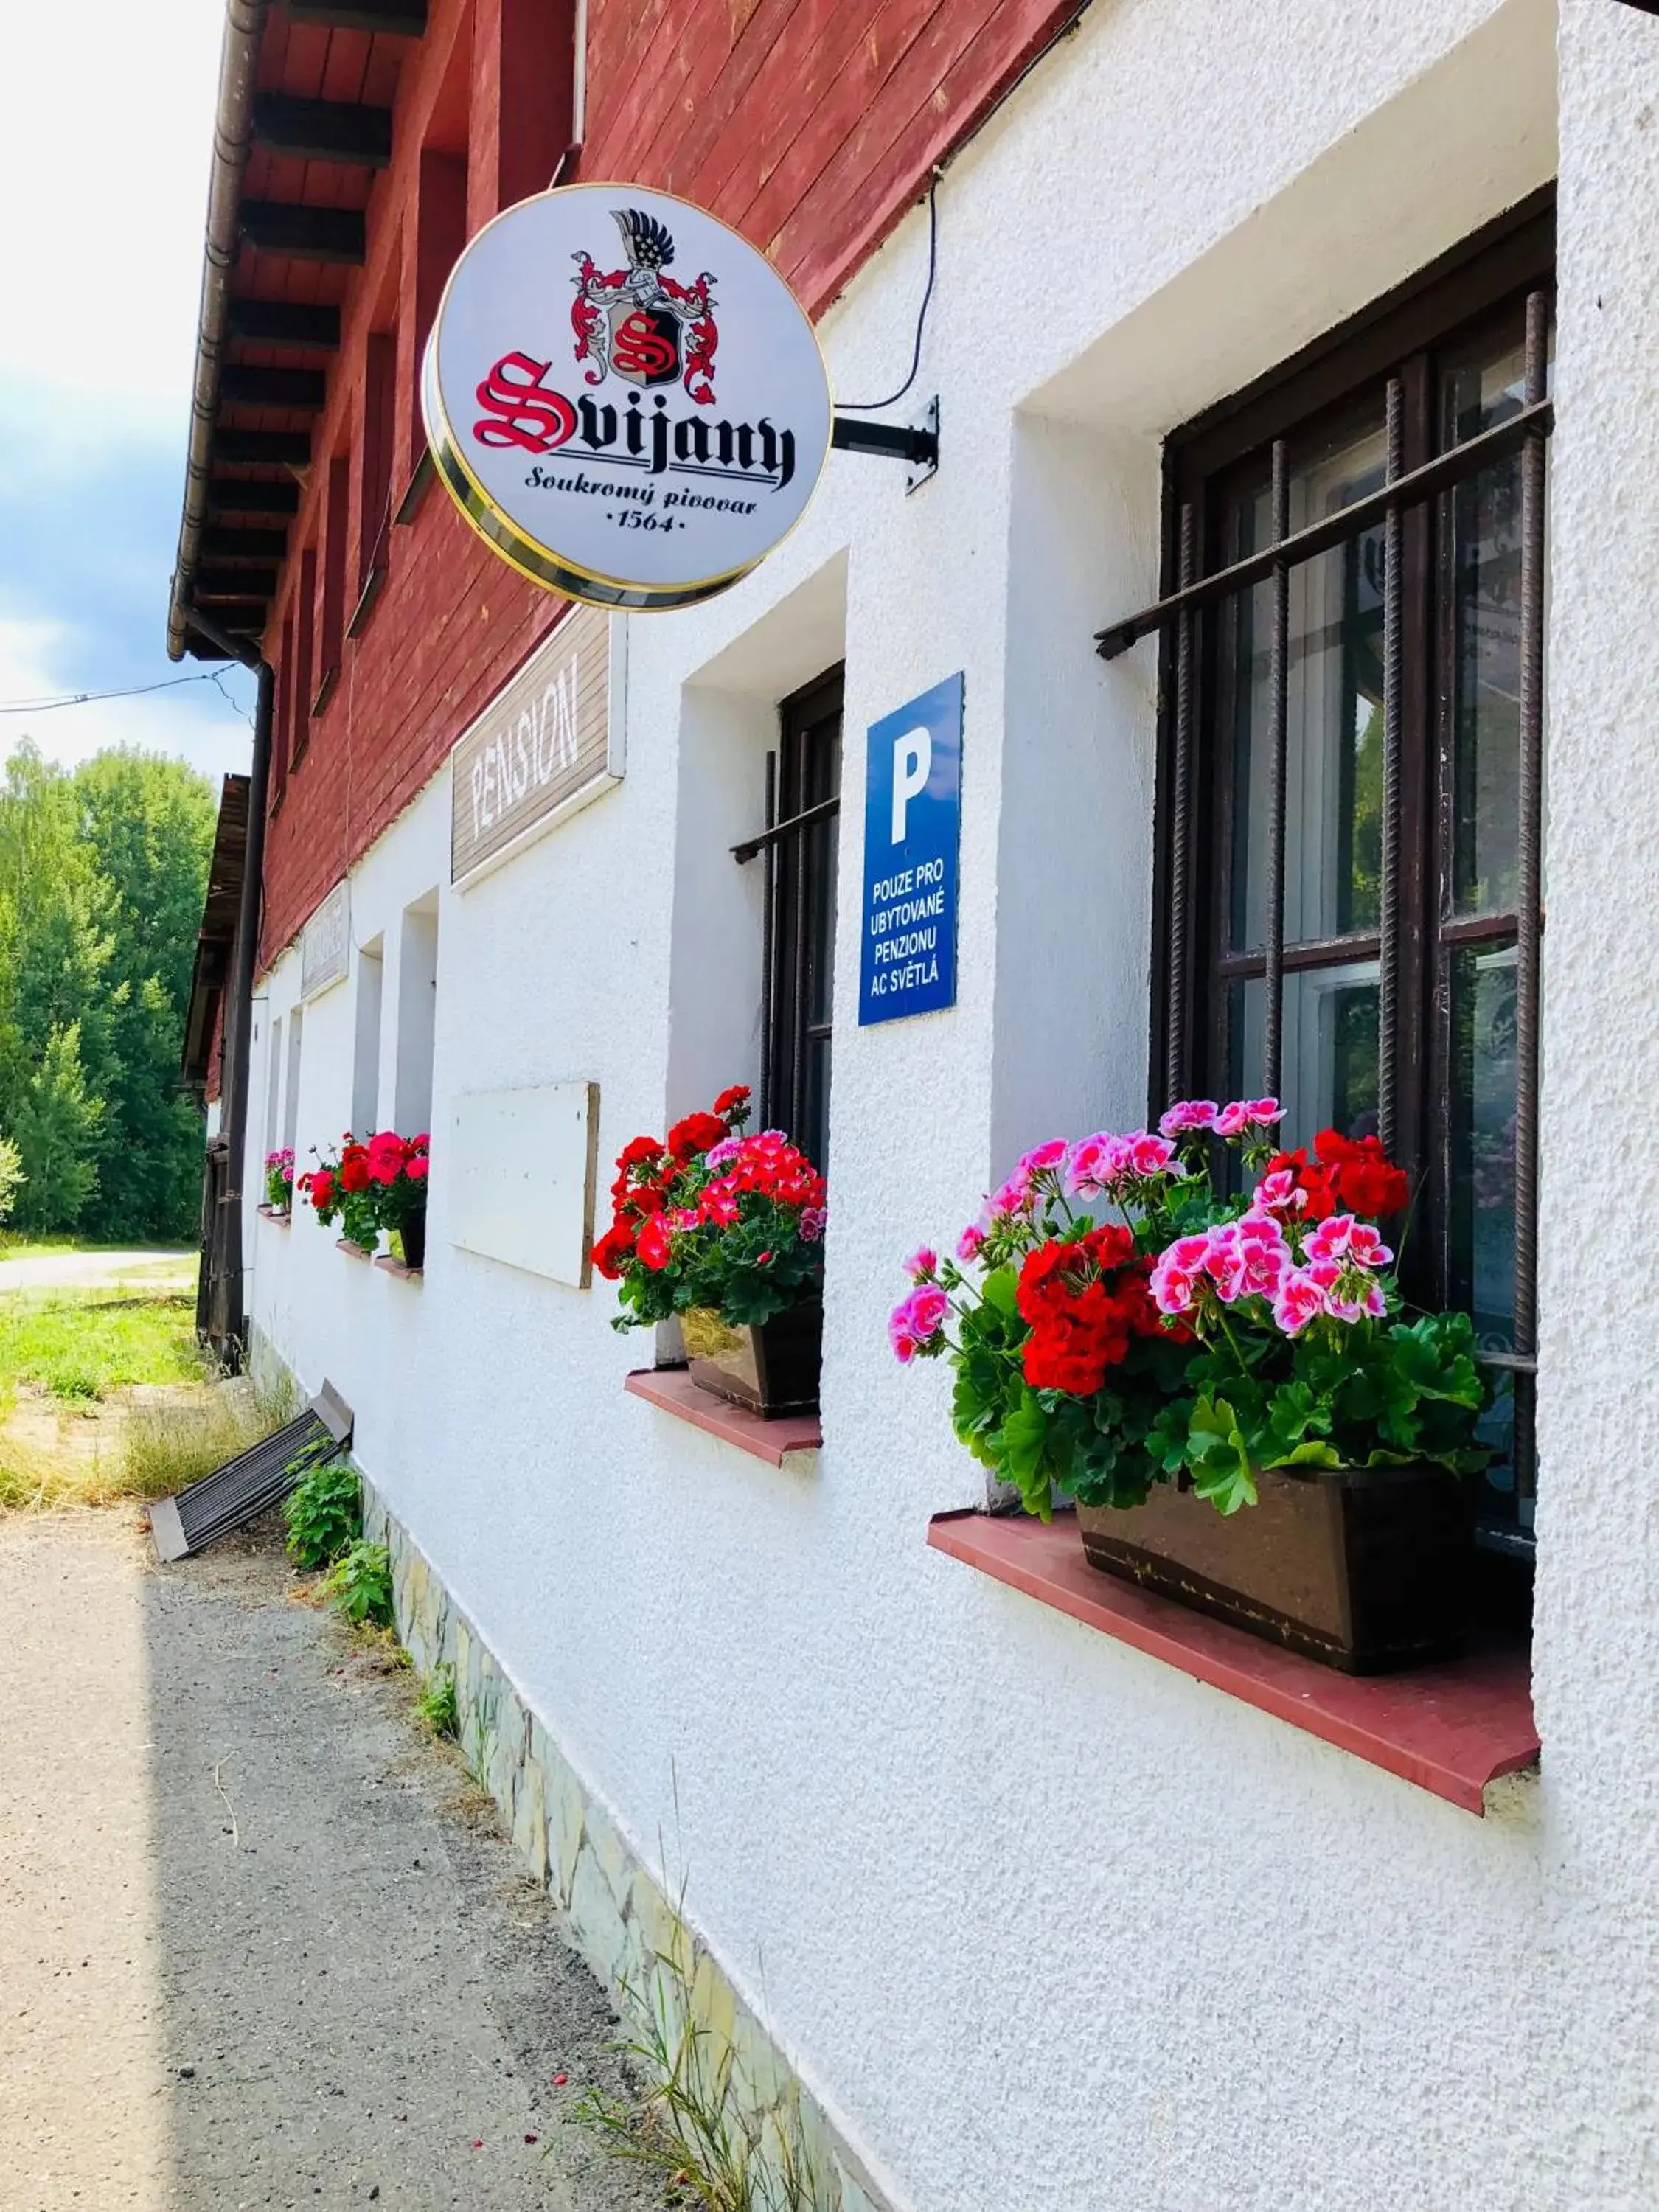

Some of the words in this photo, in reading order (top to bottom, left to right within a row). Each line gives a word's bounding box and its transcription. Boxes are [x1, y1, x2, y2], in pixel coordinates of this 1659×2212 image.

[473, 350, 796, 493] Svijany
[524, 466, 655, 506] Soukromý
[664, 487, 757, 515] pivovar
[891, 726, 931, 846] P
[873, 869, 914, 905] POUZE
[917, 858, 944, 888] PRO
[870, 885, 945, 936] UBYTOVANÉ
[874, 925, 937, 965] PENZIONU
[871, 973, 887, 997] AC
[890, 953, 939, 992] SVĚTLÁ
